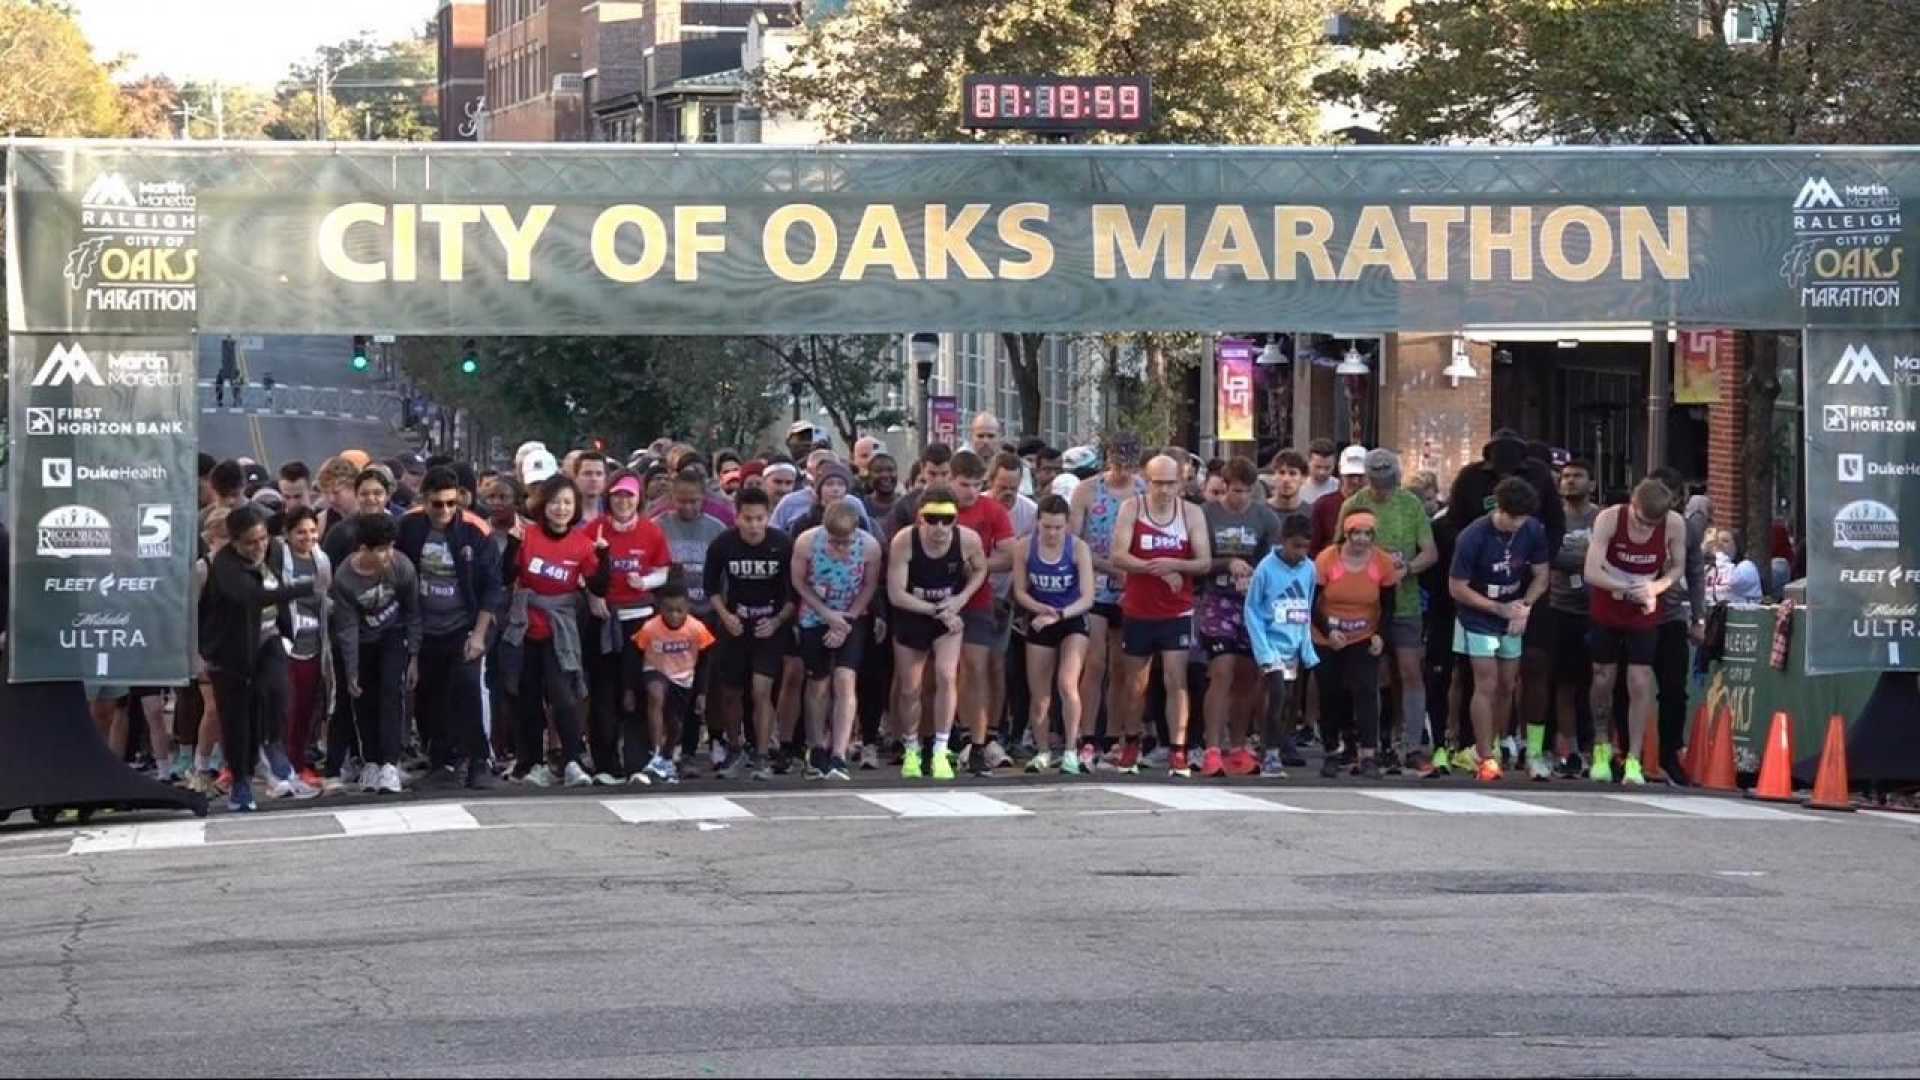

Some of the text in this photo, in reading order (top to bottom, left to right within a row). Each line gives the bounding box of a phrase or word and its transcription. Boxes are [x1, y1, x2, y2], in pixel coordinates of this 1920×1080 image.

[1846, 183, 1889, 195] Martin
[82, 211, 196, 229] RALEIGH
[1793, 214, 1901, 229] RALEIGH
[125, 236, 184, 247] CITY OF
[318, 202, 1690, 283] CITY OF OAKS MARATHON
[1835, 235, 1891, 246] CITY OF
[101, 248, 199, 281] OAKS
[1814, 248, 1904, 280] OAKS
[86, 288, 196, 311] MARATHON
[1801, 287, 1900, 307] MARATHON
[108, 352, 169, 370] Martin
[57, 408, 103, 420] FIRST
[1850, 406, 1889, 418] FIRST
[57, 422, 184, 435] HORIZON BANK
[1850, 420, 1917, 432] HORIZON
[77, 466, 168, 480] DukeHealth
[139, 506, 171, 544] 5
[728, 560, 781, 576] DUKE
[1840, 569, 1888, 582] FLEET
[45, 577, 159, 591] FLEET FEET
[1853, 619, 1920, 637] ULTR
[59, 629, 147, 648] ULTRA
